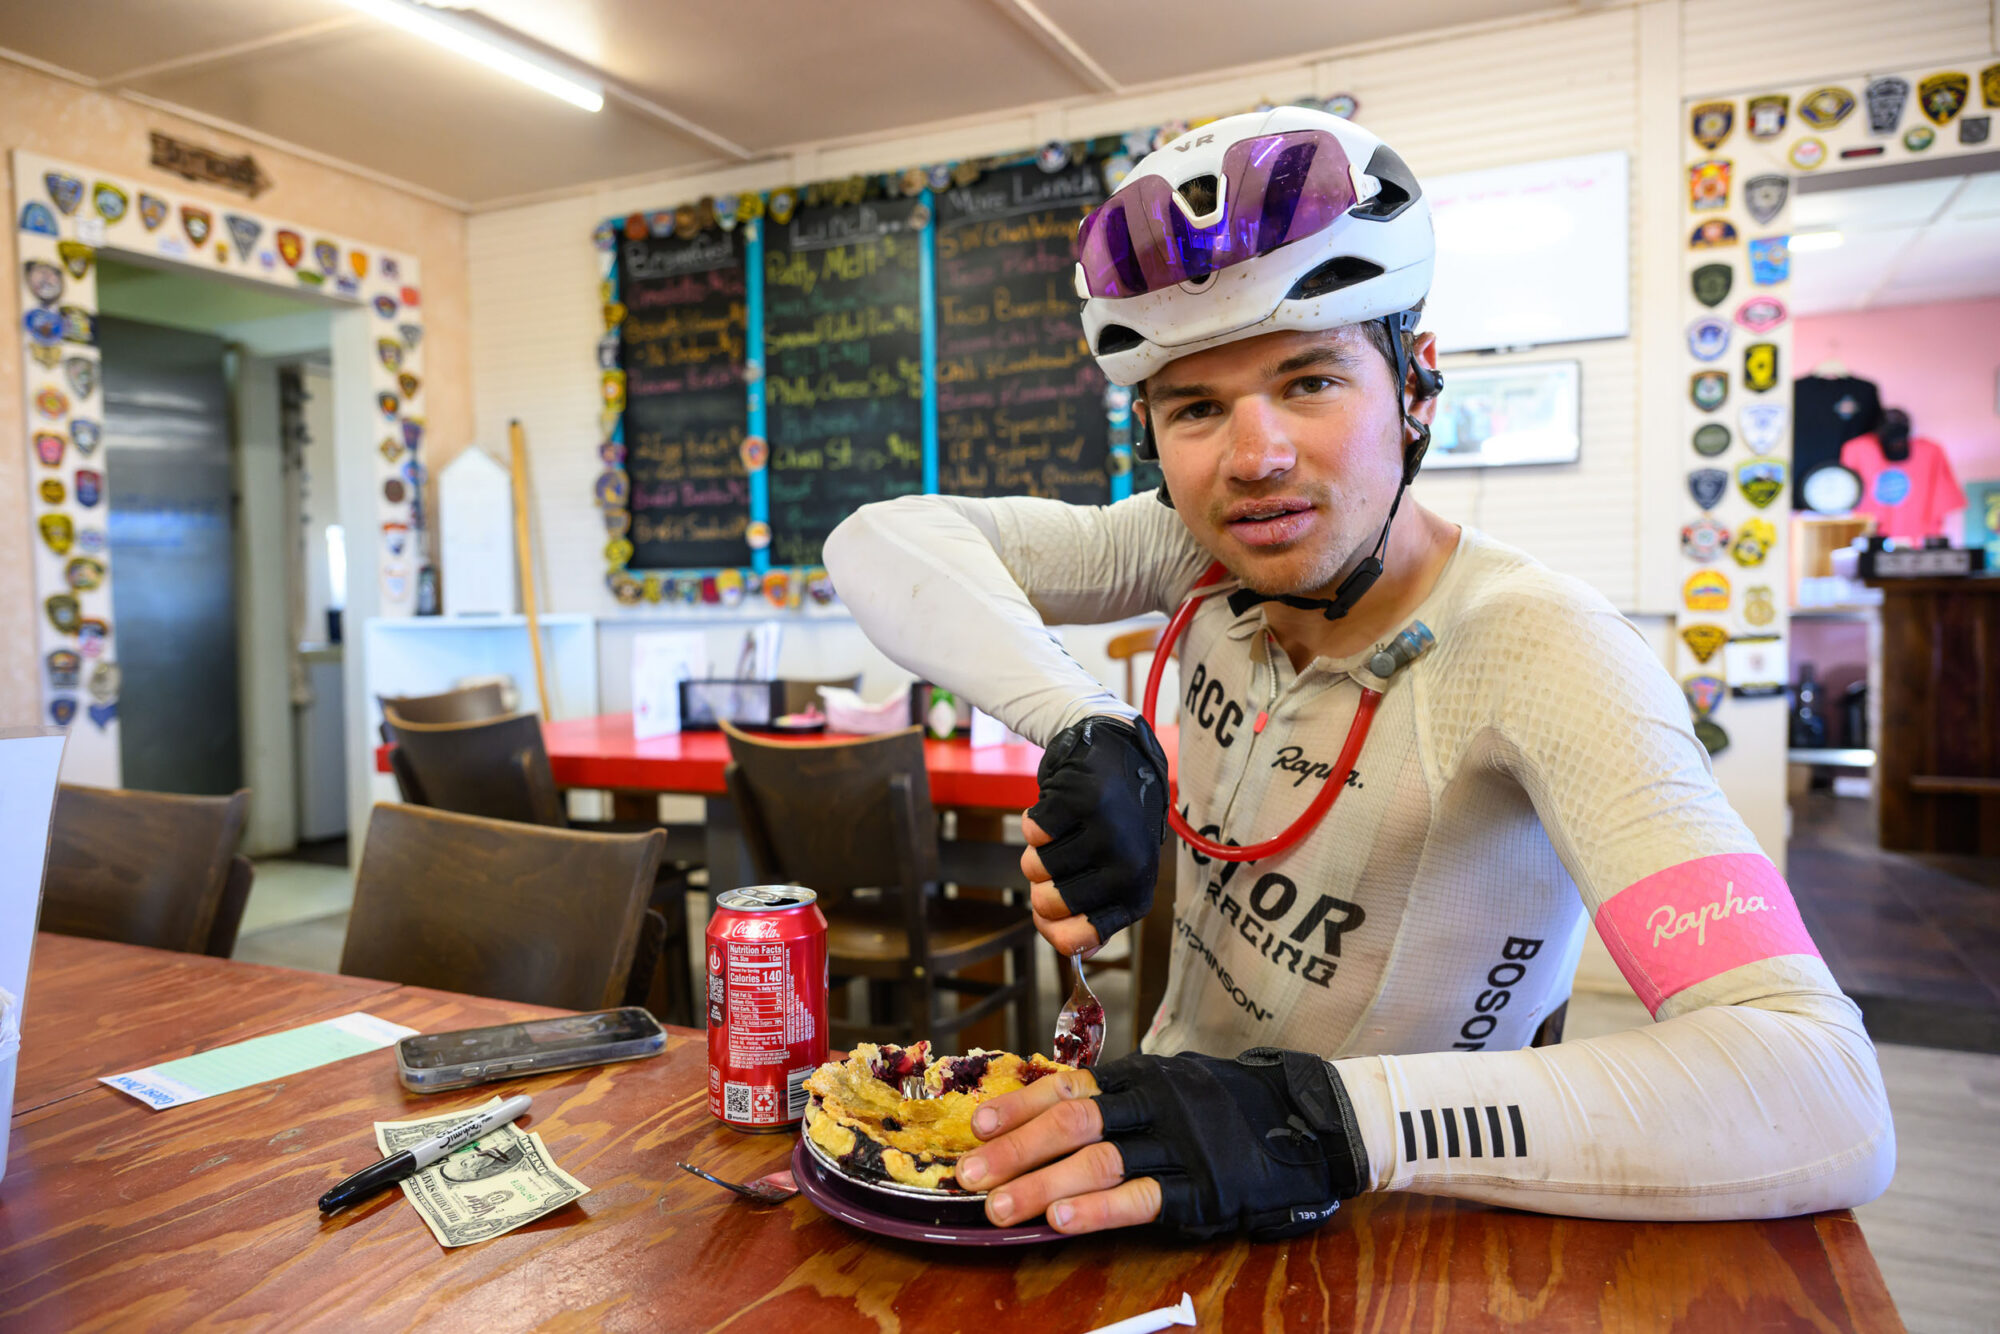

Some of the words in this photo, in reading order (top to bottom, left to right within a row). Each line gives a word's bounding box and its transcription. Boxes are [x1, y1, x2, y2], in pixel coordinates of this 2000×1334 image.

[1174, 134, 1215, 153] VR
[1185, 663, 1244, 749] RCC
[1271, 745, 1364, 789] Rapa.
[1646, 881, 1777, 948] Rapha.
[1204, 881, 1338, 989] RACING
[730, 944, 759, 954] Nutrition
[761, 945, 782, 954] Facts
[730, 972, 760, 983] Calories
[762, 969, 782, 982] 140
[1297, 1211, 1317, 1220] GEL
[1320, 1200, 1340, 1217] DUAL
